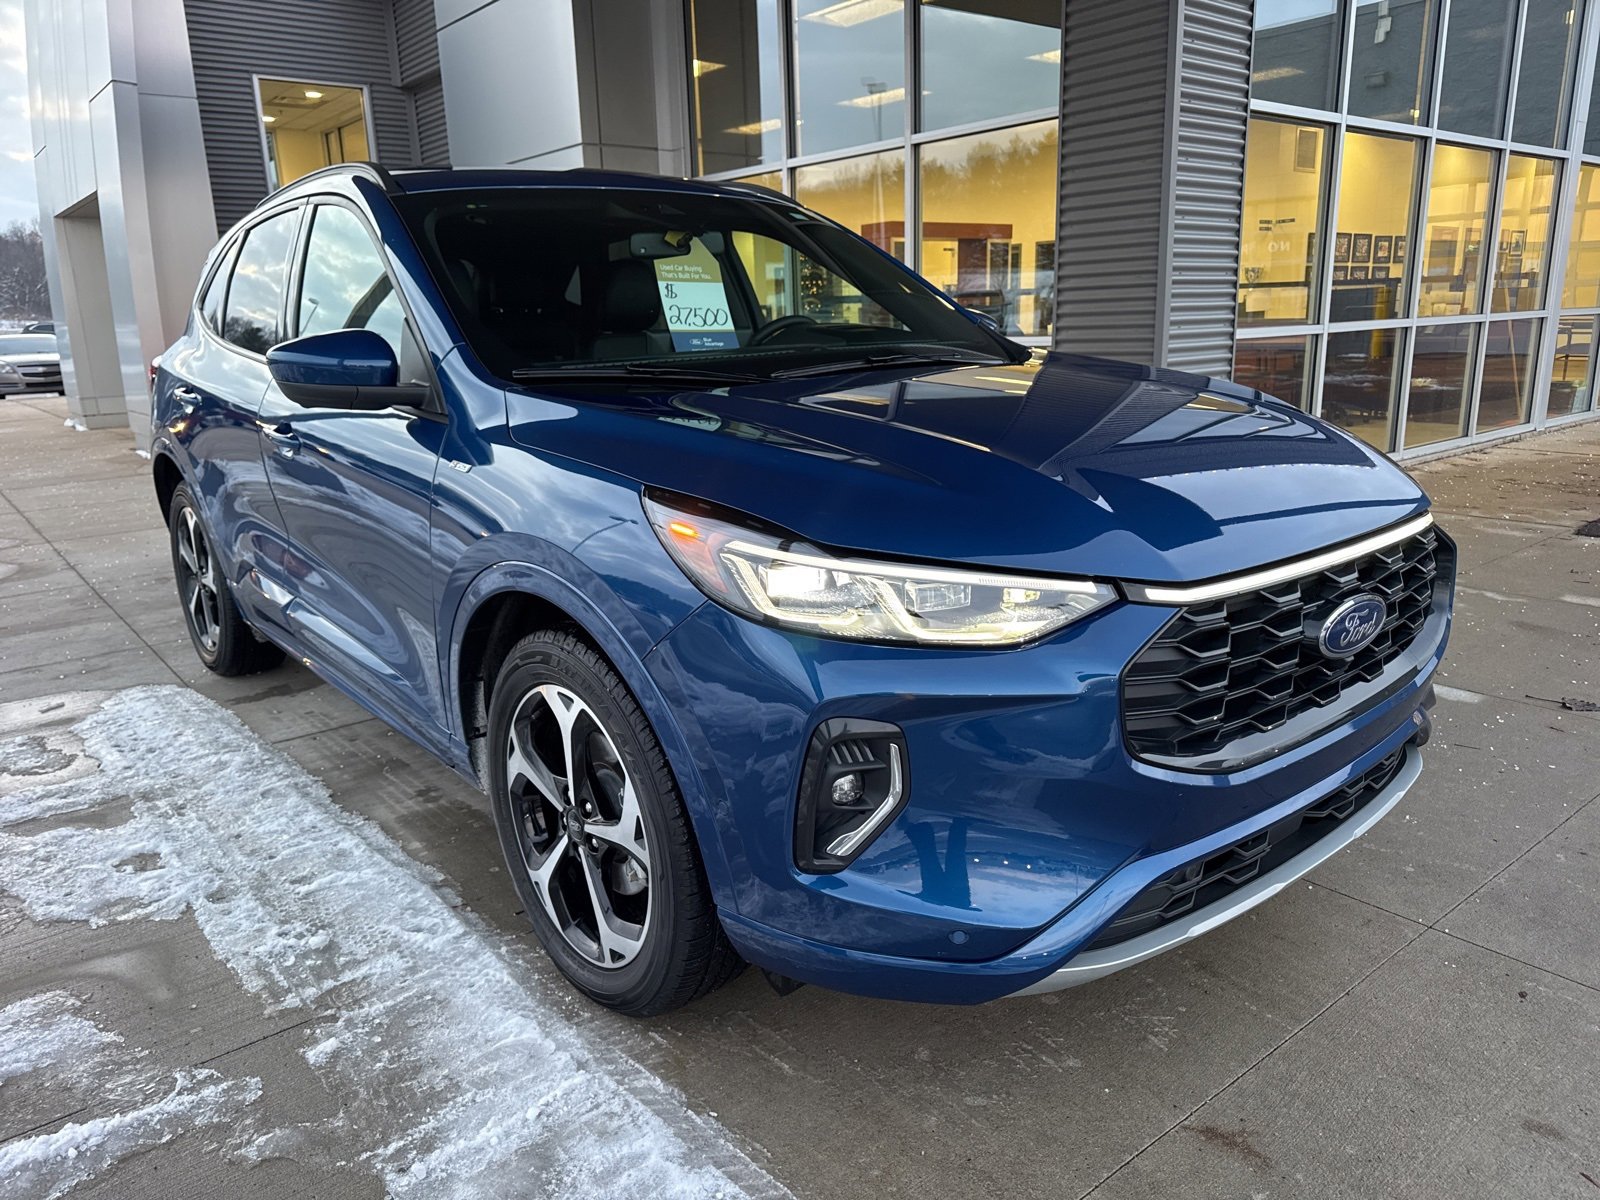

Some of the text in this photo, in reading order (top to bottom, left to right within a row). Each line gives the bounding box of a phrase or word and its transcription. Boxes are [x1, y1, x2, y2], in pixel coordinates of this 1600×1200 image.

[684, 264, 703, 273] Buying
[664, 283, 678, 299] $
[1340, 608, 1378, 647] Ford
